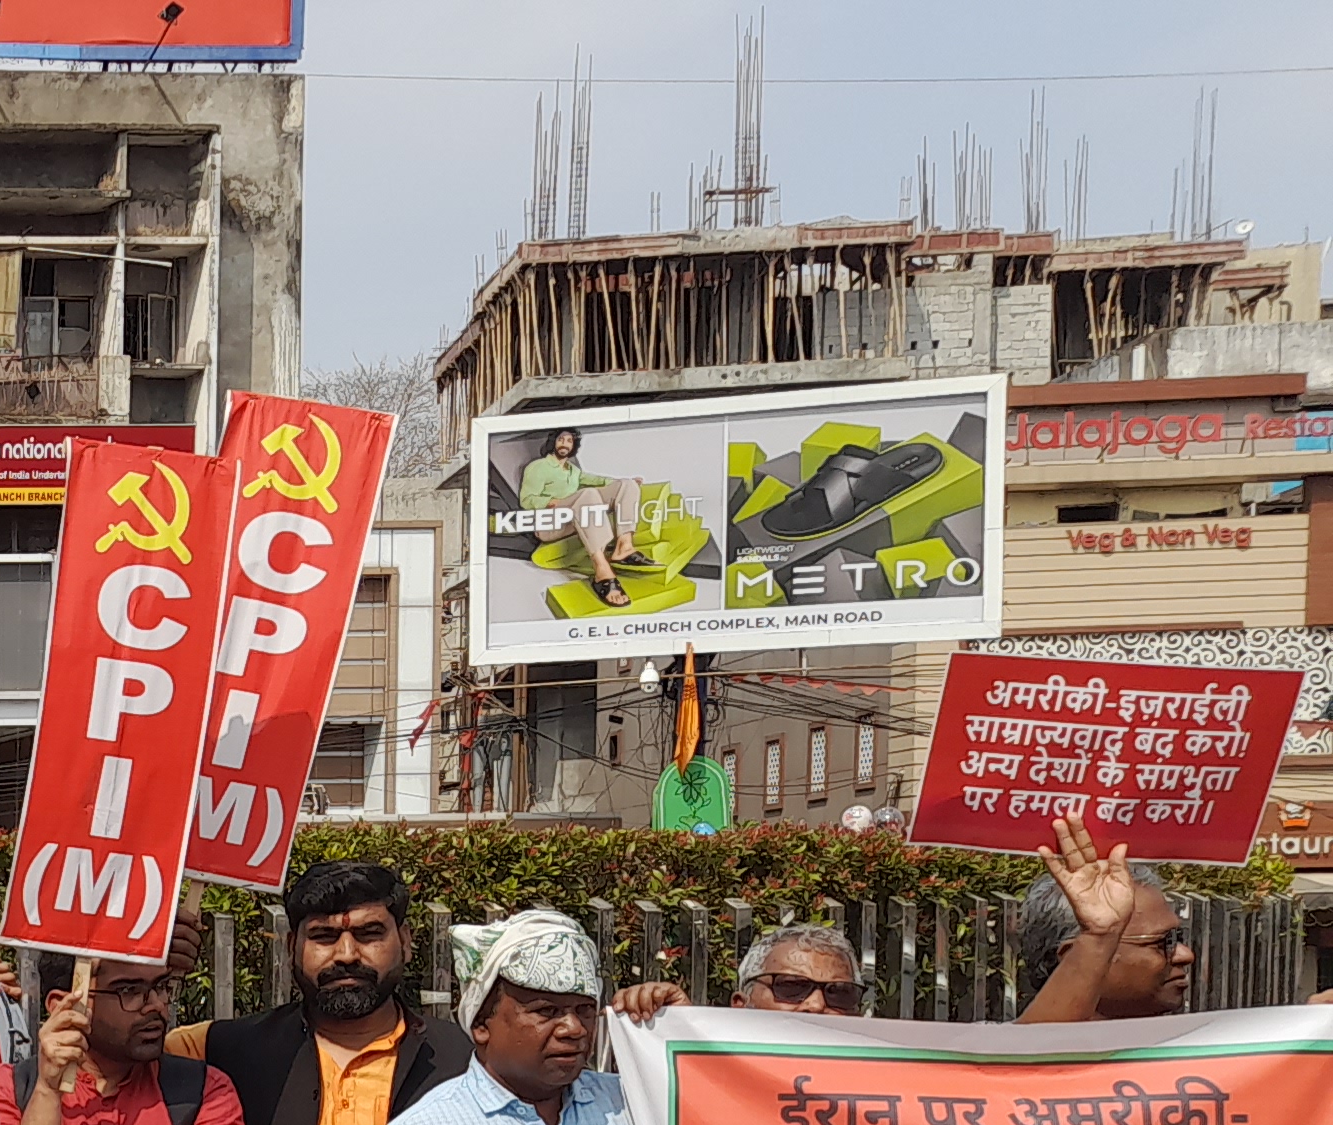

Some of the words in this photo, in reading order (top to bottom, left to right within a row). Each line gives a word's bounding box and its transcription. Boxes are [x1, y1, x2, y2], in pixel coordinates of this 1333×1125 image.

[1006, 410, 1224, 454] Jalajoga
[9, 471, 30, 480] India
[494, 508, 575, 533] KEEP
[581, 502, 610, 529] IT
[616, 496, 703, 527] LIGHT
[1067, 528, 1117, 553] Veg
[1120, 527, 1137, 548] &
[1147, 526, 1195, 548] Non
[1202, 522, 1253, 549] Veg
[736, 556, 981, 600] METRO
[568, 626, 584, 639] G.
[588, 626, 602, 638] E.
[606, 625, 619, 637] L.
[623, 620, 692, 635] CHURCH
[696, 615, 779, 632] COMPLEX,
[785, 612, 828, 628] MAIN
[833, 609, 882, 624] ROAD
[985, 675, 1252, 725] अमरीकी-इज़राईली
[964, 714, 1129, 758] साम्राज्यवाद
[1134, 722, 1175, 758] बंद
[1184, 719, 1251, 758] करो!
[960, 750, 1023, 780] अन्य
[1029, 746, 1091, 784] देशों
[1097, 751, 1129, 788] के
[1136, 758, 1240, 798] संप्रभुता
[963, 785, 1003, 813] पर
[1008, 787, 1090, 820] हमला
[1096, 791, 1136, 826] बंद
